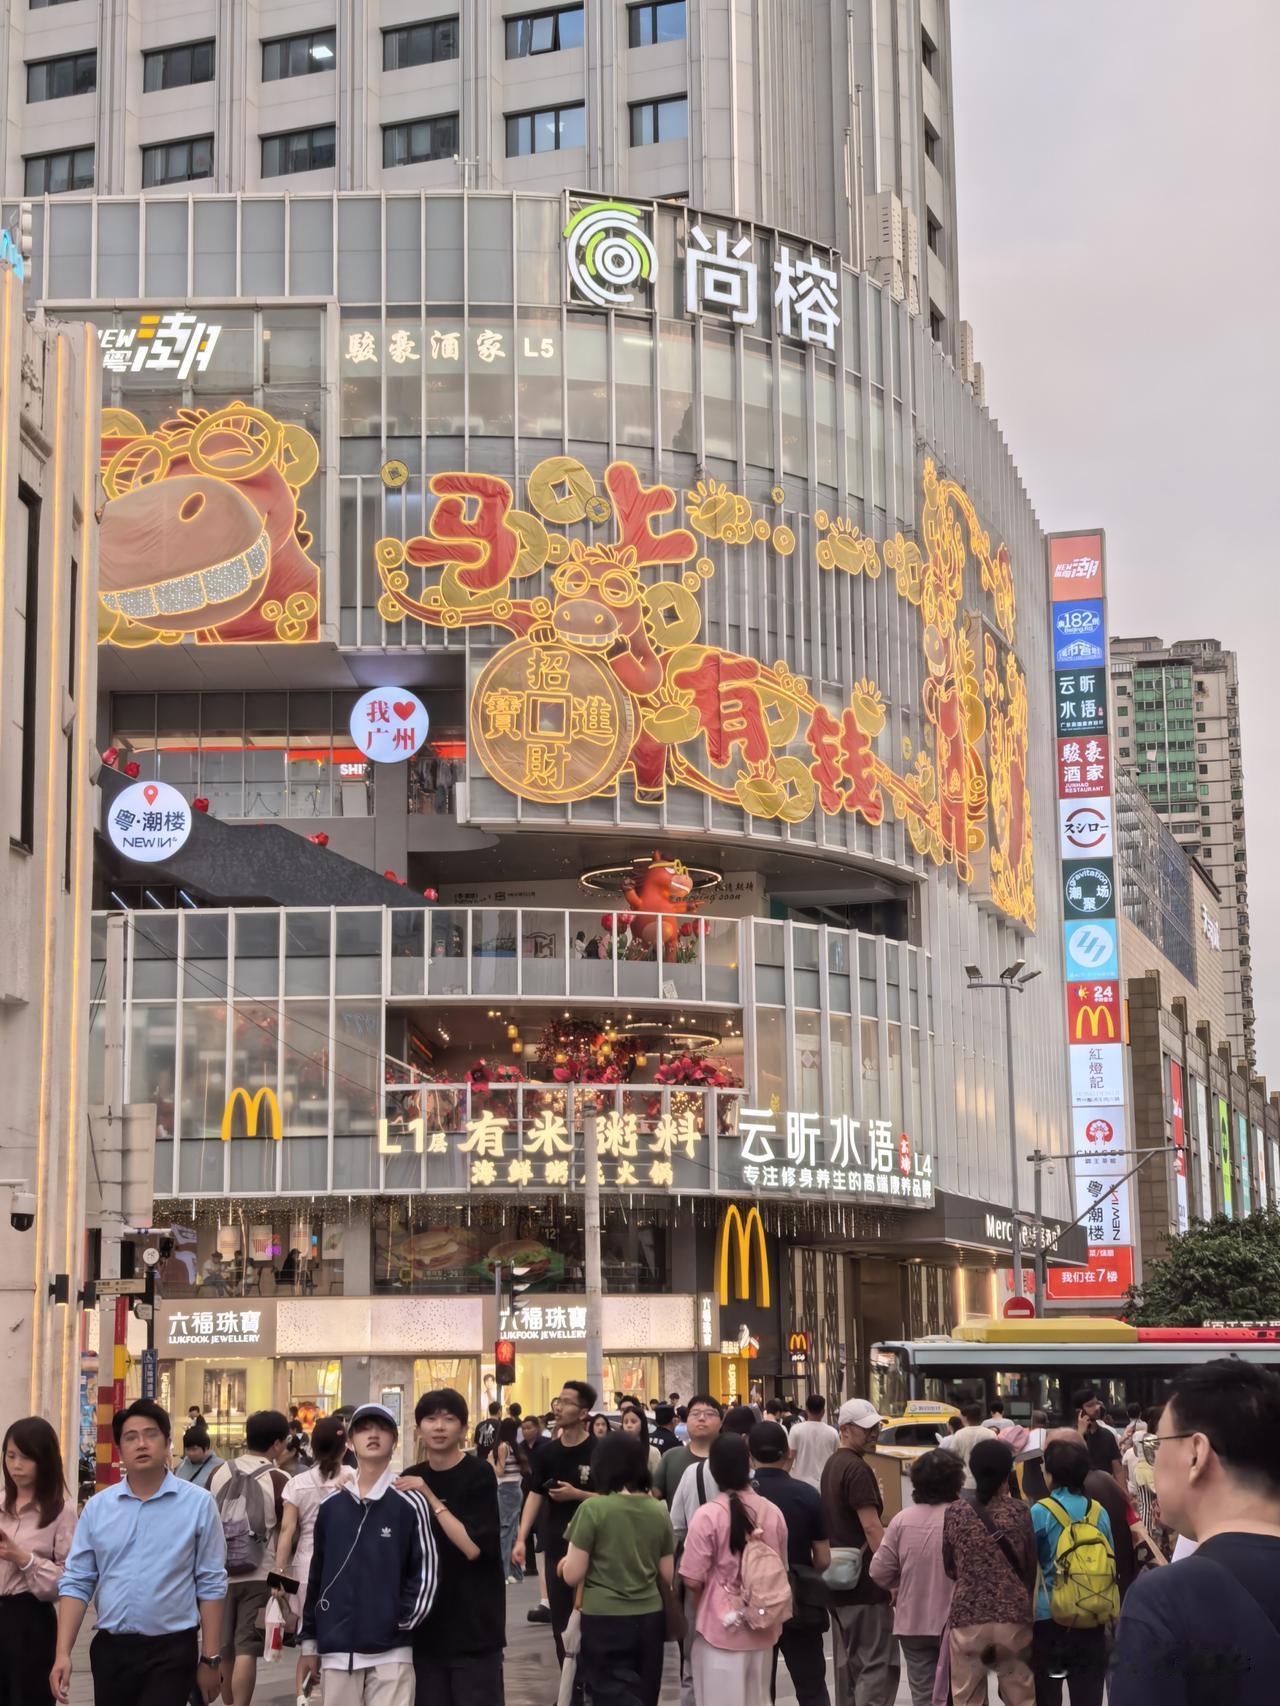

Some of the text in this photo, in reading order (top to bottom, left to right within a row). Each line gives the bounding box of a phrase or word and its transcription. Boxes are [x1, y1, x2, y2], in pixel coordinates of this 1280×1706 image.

[684, 226, 842, 350] 尚榕
[345, 330, 554, 364] 駿豪酒家 L5
[404, 460, 698, 593] 马上
[1064, 612, 1092, 627] 182
[1060, 675, 1096, 695] 云昕
[366, 700, 390, 723] 我
[1060, 700, 1097, 719] 水语
[366, 727, 415, 751] 广州
[1061, 740, 1105, 763] 駿豪
[1063, 764, 1104, 782] 酒家
[114, 809, 185, 832] 粤·潮楼
[1064, 823, 1110, 834] スシロー
[1094, 985, 1113, 998] 24
[739, 1108, 894, 1172] 云昕水语
[914, 1152, 932, 1177] L4
[743, 1164, 932, 1199] 专注修身养生的高端康养品牌
[168, 1310, 261, 1336] 六福珠寶
[168, 1334, 261, 1344] LUKFOOK JEWELLERY
[540, 1330, 587, 1340] JEWELLERY
